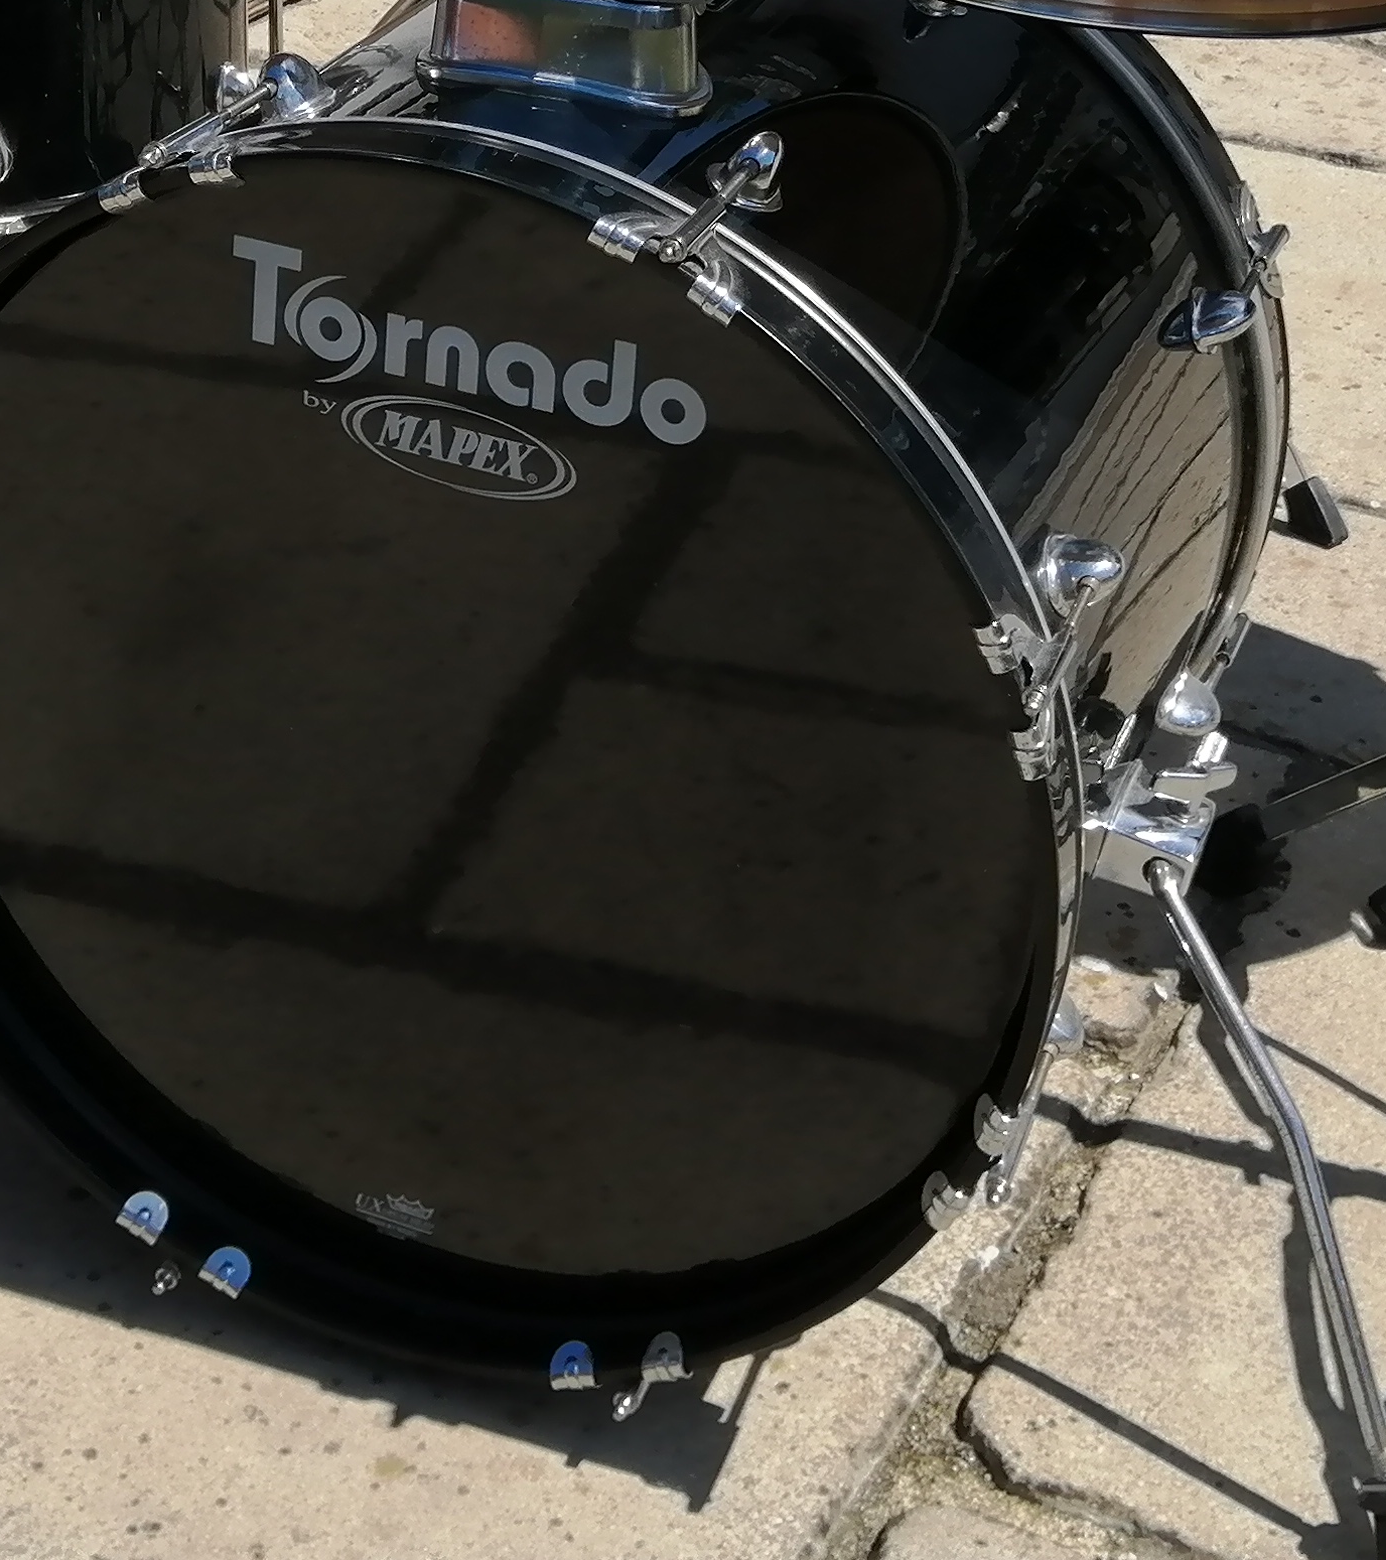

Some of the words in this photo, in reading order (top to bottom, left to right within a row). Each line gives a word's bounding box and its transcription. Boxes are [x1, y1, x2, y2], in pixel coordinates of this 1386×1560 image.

[233, 235, 706, 445] Tornado
[302, 390, 337, 415] by
[374, 409, 539, 482] MAPEX
